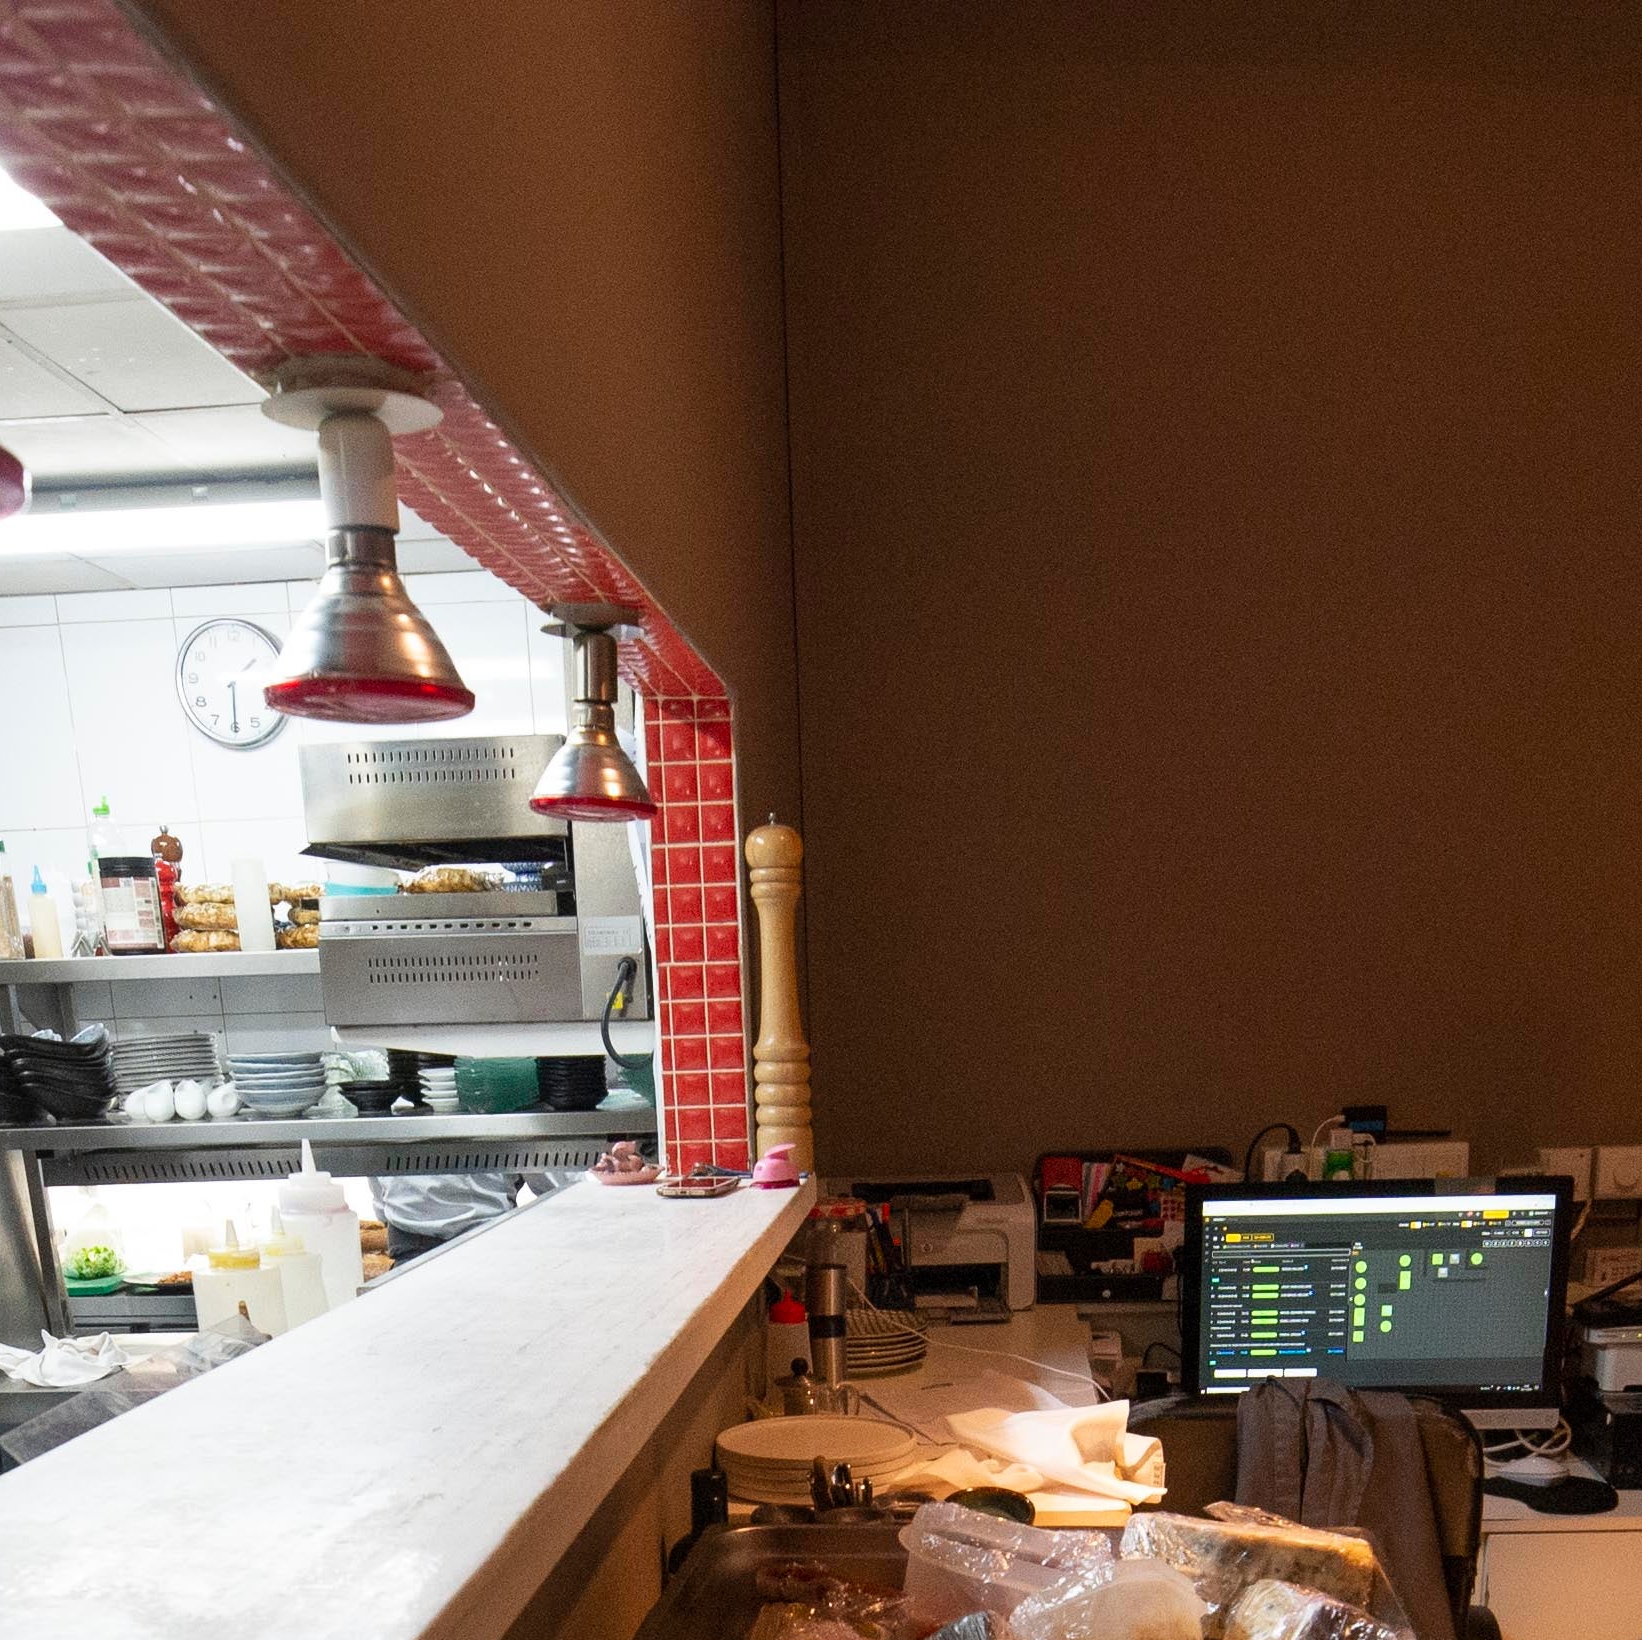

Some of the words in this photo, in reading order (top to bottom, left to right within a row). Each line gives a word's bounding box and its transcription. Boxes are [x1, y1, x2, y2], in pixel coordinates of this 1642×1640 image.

[188, 672, 199, 684] 9
[195, 696, 207, 708] 8
[210, 714, 220, 726] 7
[250, 717, 261, 729] 5
[230, 721, 241, 733] 6
